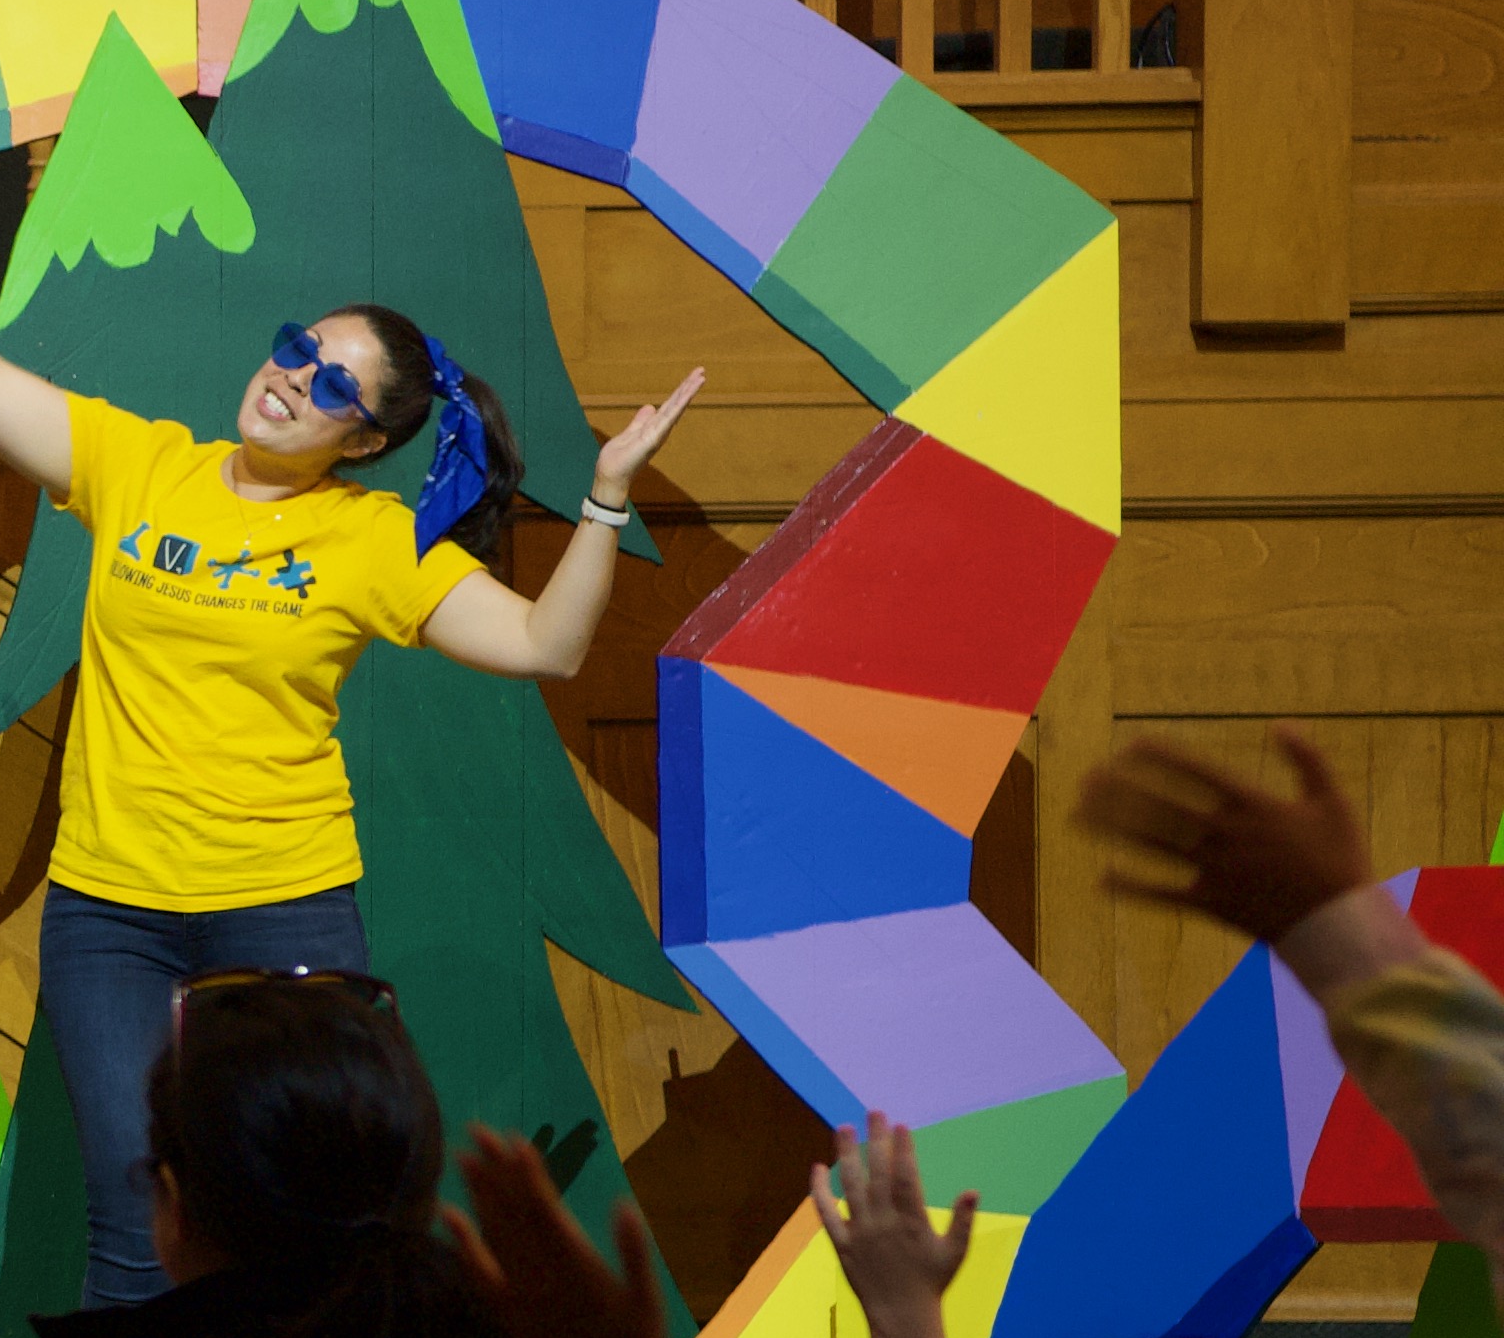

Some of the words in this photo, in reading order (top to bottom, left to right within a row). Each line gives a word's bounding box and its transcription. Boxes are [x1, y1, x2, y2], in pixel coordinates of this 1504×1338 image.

[156, 581, 192, 603] JESUS
[194, 593, 246, 611] CHANGES
[250, 598, 269, 612] THE
[273, 601, 304, 619] GAME
